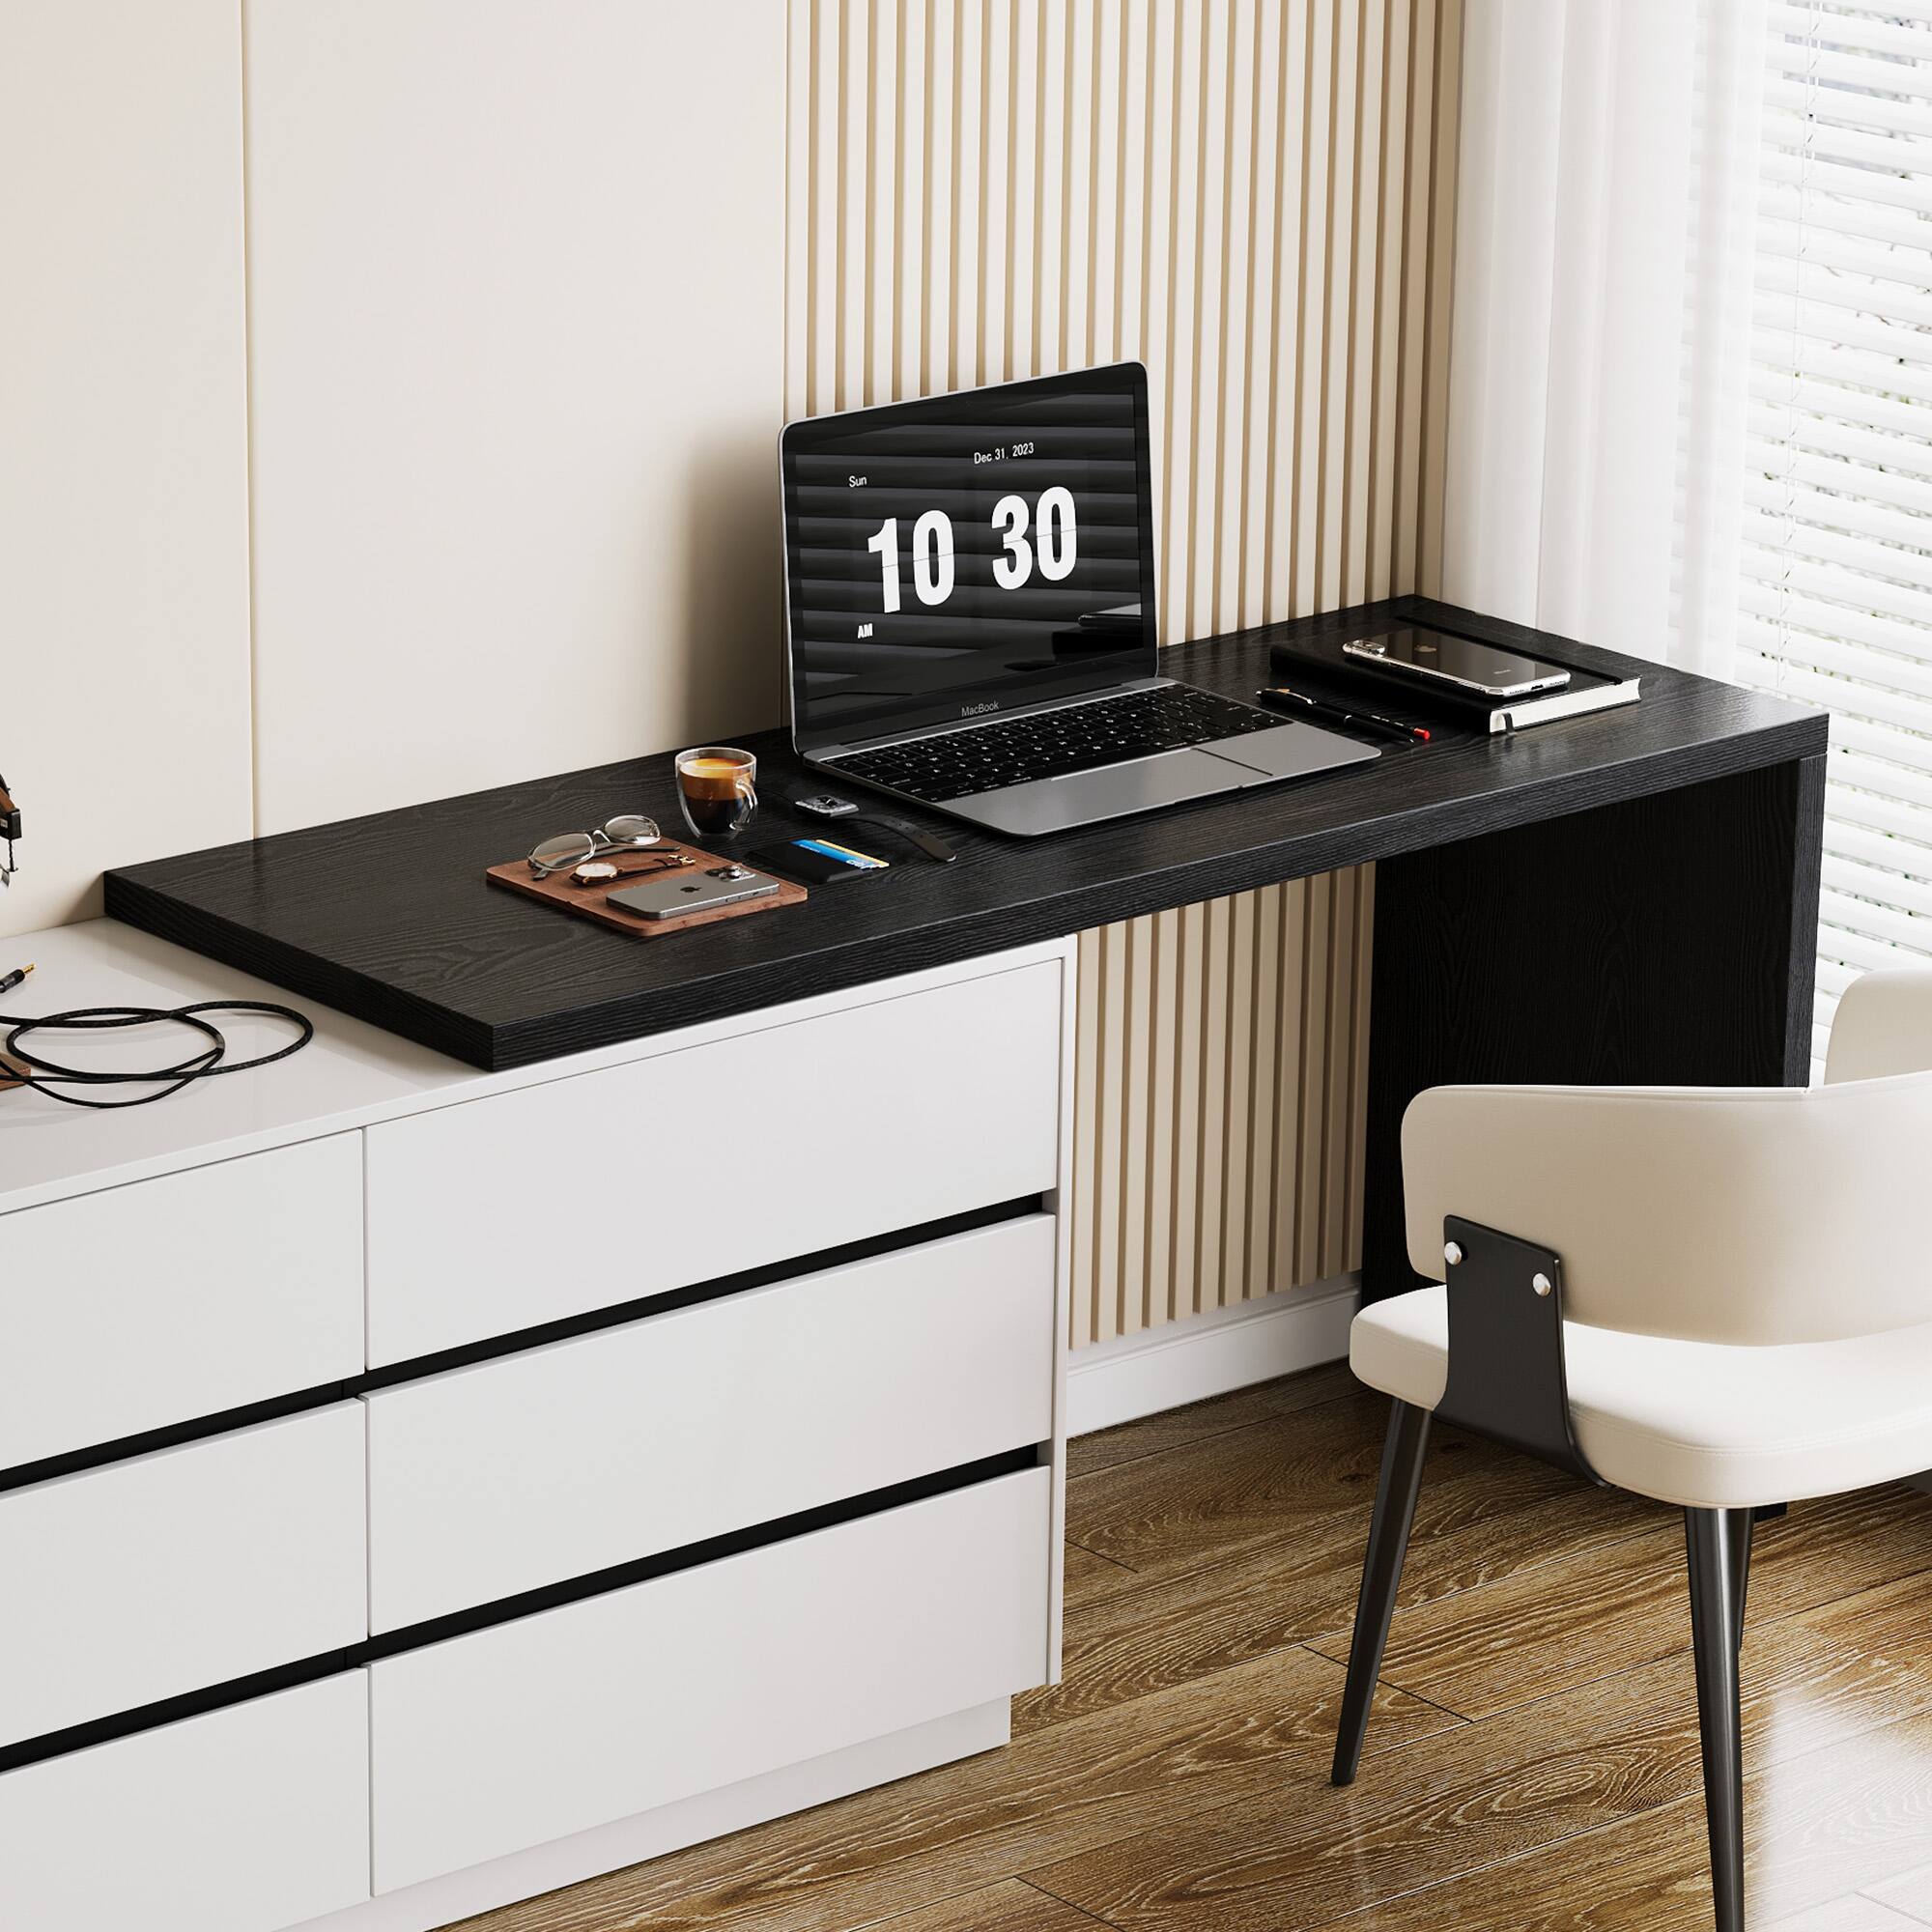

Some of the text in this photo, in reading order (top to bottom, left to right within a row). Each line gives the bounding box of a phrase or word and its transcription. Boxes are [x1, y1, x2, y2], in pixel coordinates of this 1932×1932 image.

[974, 451, 993, 465] Dec
[1011, 441, 1035, 457] 2023
[848, 475, 867, 488] Sun
[867, 486, 1077, 613] 10 30
[857, 622, 873, 639] AM
[961, 700, 1000, 717] MacBook
